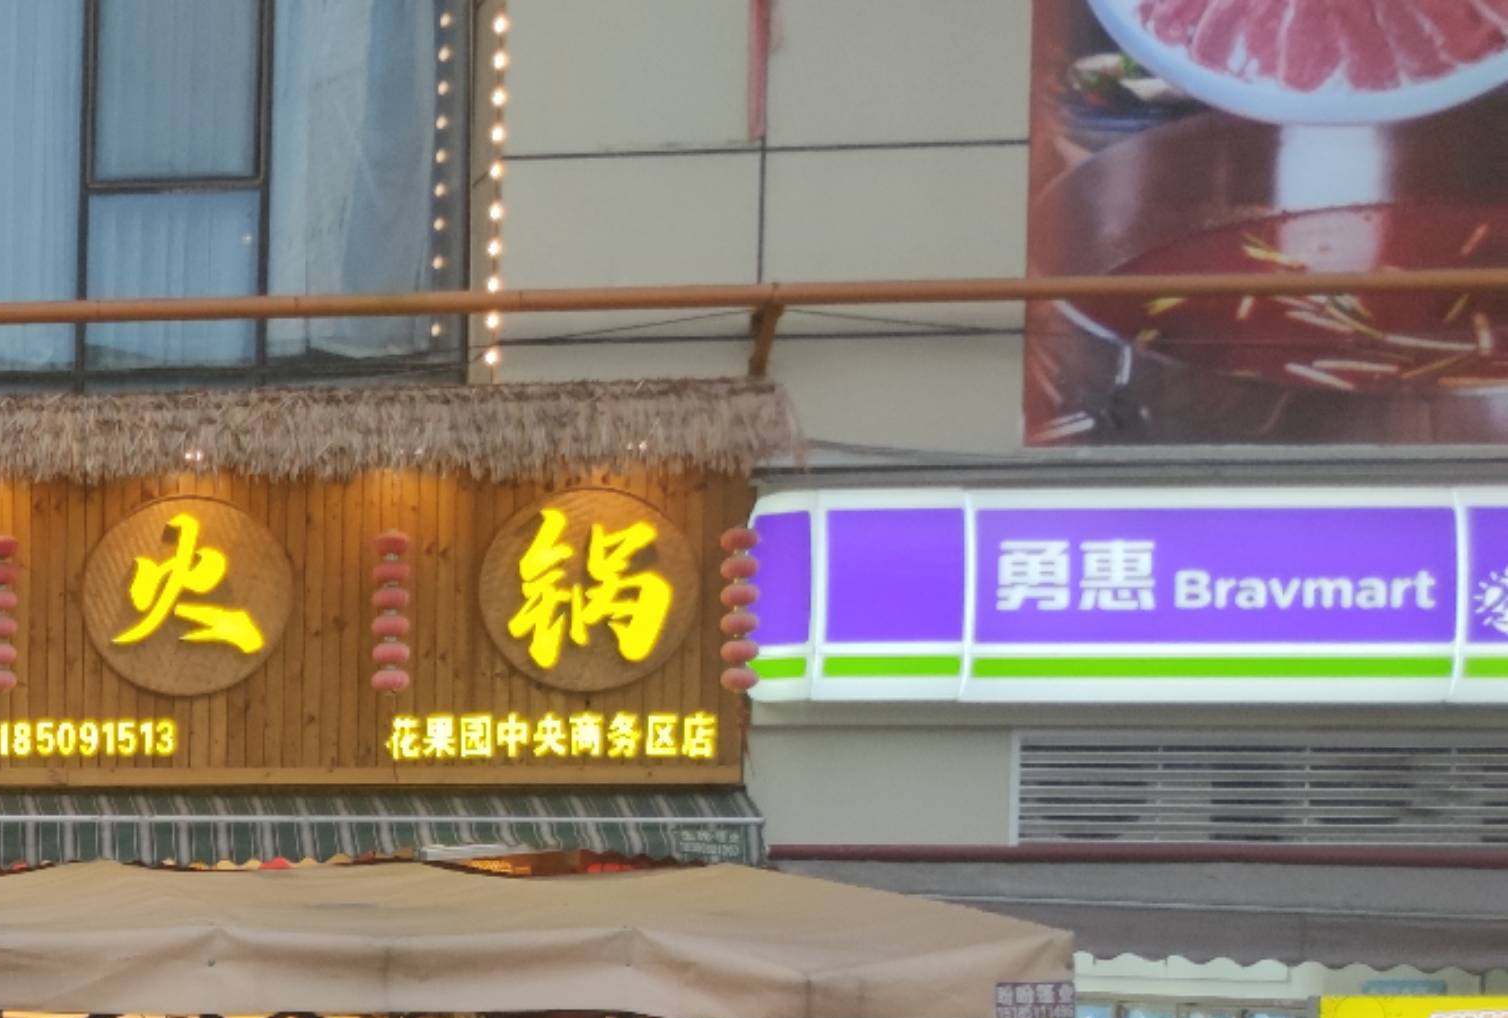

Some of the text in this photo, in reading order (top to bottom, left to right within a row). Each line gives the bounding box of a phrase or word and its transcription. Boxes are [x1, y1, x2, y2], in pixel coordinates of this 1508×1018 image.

[996, 538, 1436, 611] 勇惠 Bravmart
[386, 712, 715, 760] 花果园中央商务区店
